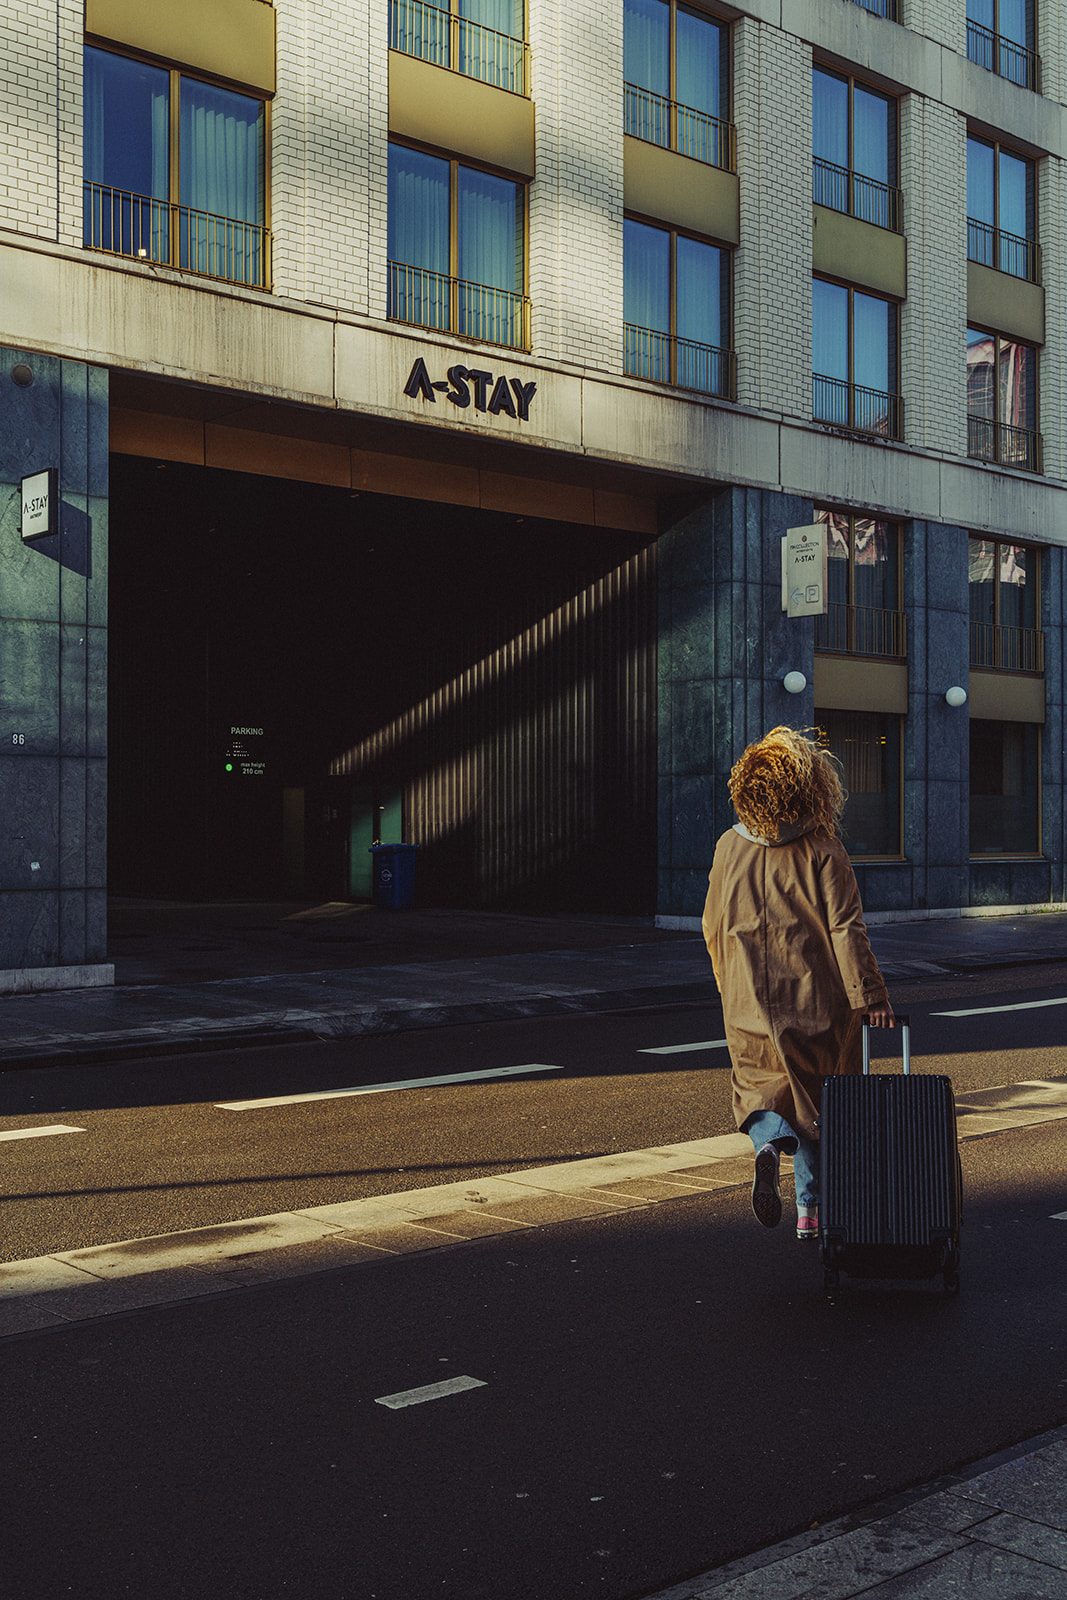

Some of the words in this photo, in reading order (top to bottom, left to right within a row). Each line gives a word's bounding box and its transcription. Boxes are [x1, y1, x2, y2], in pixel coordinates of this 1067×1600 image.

[403, 357, 538, 422] A-STAY
[23, 494, 49, 514] A-STAY
[794, 554, 816, 564] A-STAY
[230, 726, 264, 736] PARKING
[12, 733, 25, 745] 86
[242, 767, 254, 775] 210
